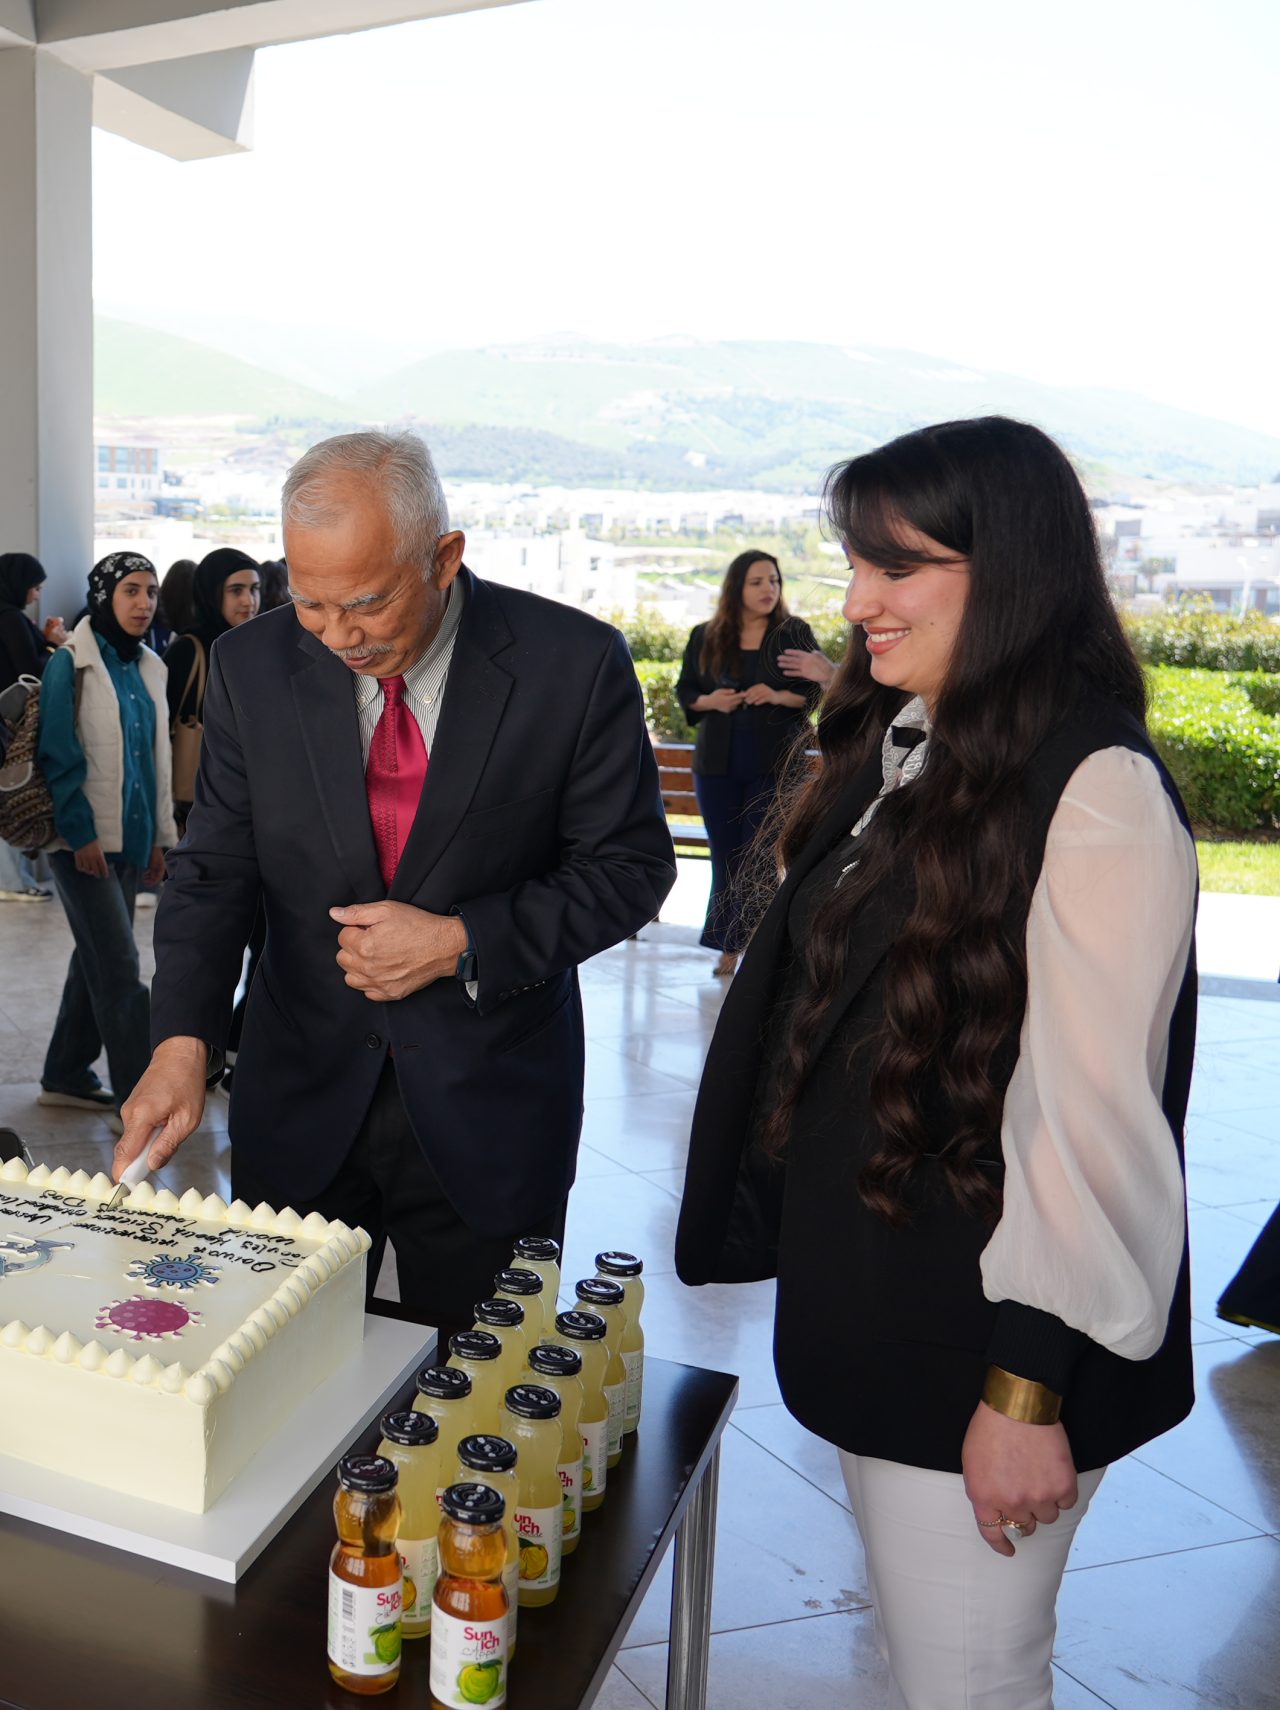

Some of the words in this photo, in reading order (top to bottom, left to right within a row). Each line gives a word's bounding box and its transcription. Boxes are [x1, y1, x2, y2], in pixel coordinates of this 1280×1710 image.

[39, 1189, 86, 1208] Day
[514, 1513, 531, 1524] un
[376, 1591, 399, 1606] Sun
[464, 1626, 493, 1641] Sun
[480, 1635, 500, 1650] ich
